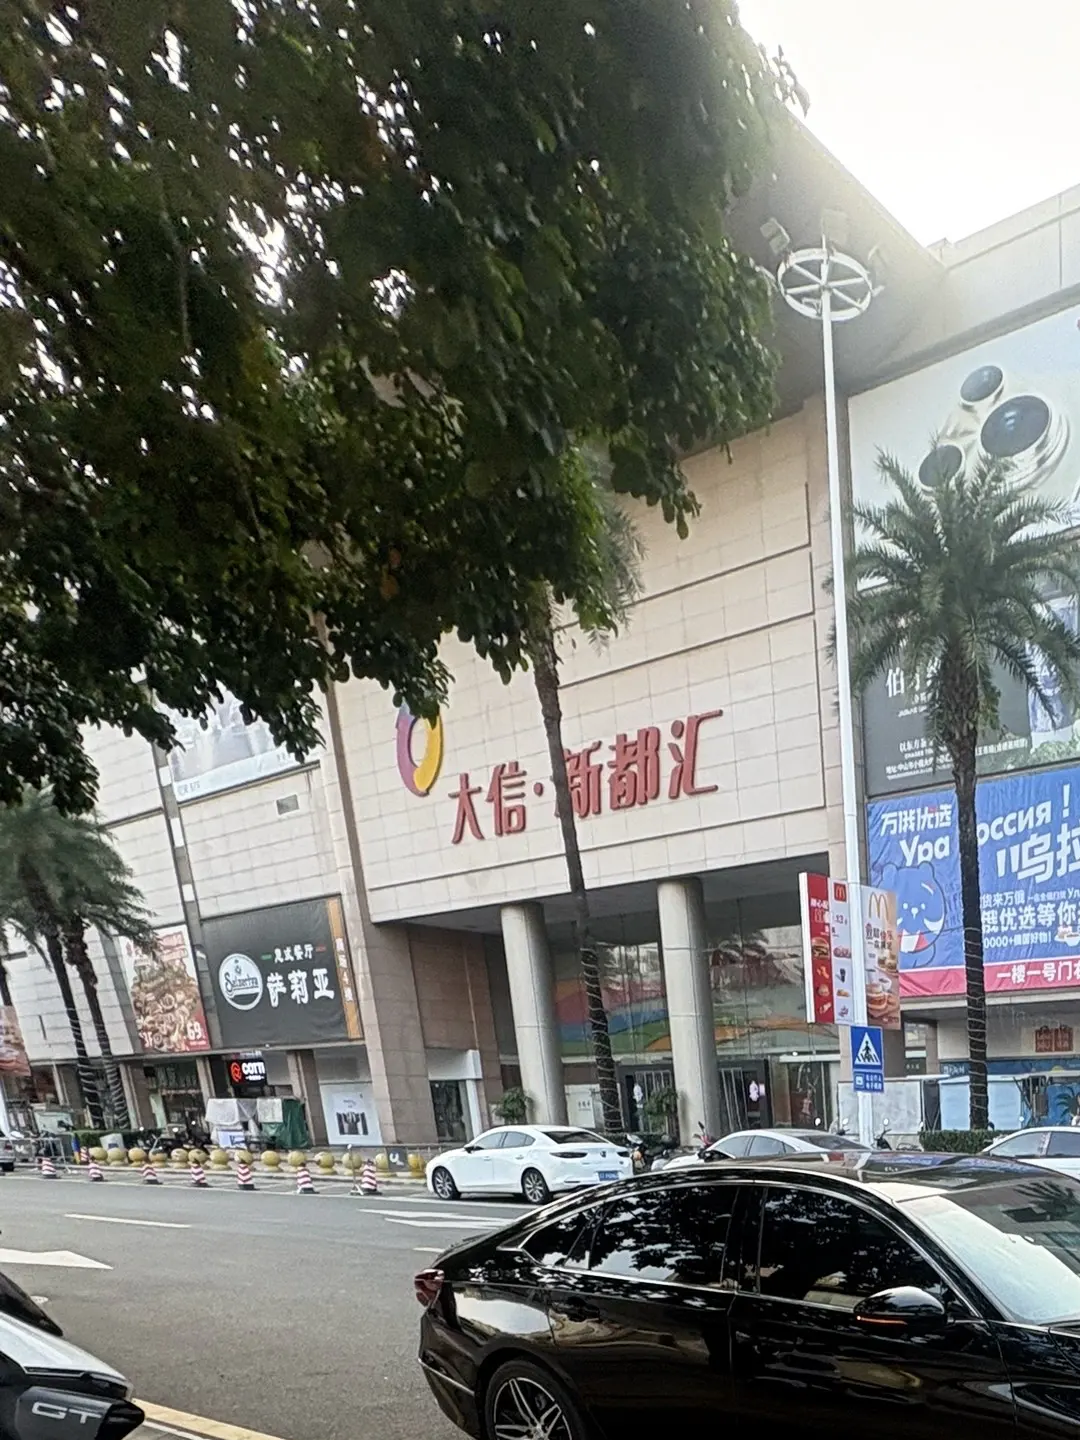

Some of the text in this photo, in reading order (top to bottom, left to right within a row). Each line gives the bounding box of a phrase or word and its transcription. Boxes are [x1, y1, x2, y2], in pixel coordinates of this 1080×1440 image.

[266, 968, 335, 1007] 萨莉亚
[31, 1401, 103, 1424] GT
